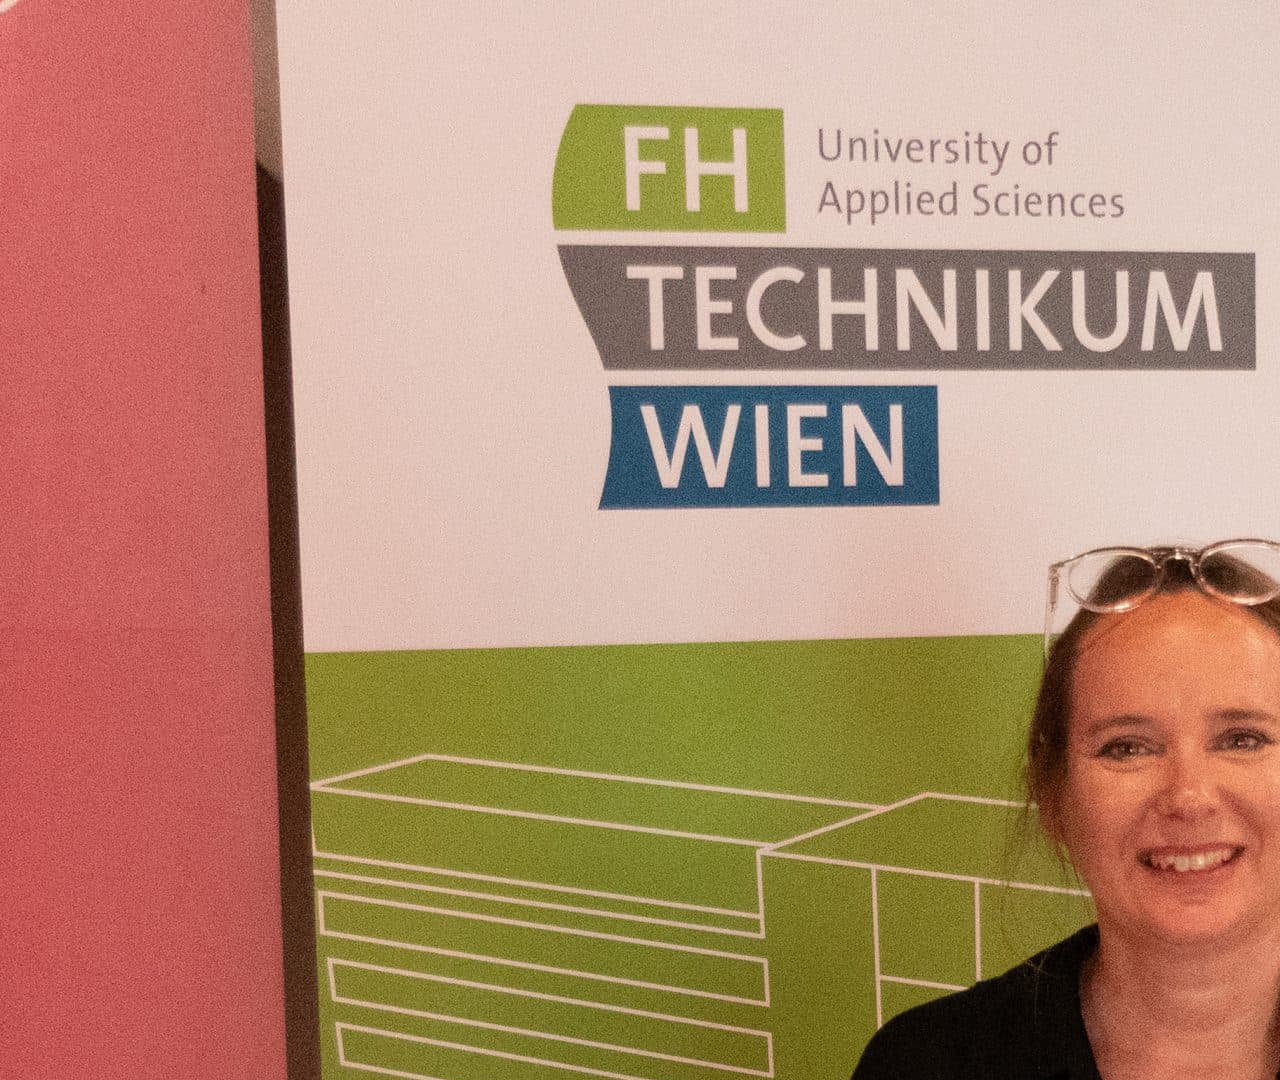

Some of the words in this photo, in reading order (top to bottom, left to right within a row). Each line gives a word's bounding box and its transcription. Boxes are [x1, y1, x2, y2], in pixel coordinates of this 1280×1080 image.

[623, 126, 748, 213] FH
[818, 128, 1010, 176] University
[1022, 131, 1060, 165] of
[817, 180, 959, 226] Applied
[972, 183, 1126, 218] Sciences
[626, 265, 1224, 352] TECHNIKUM
[640, 403, 904, 489] WIEN
